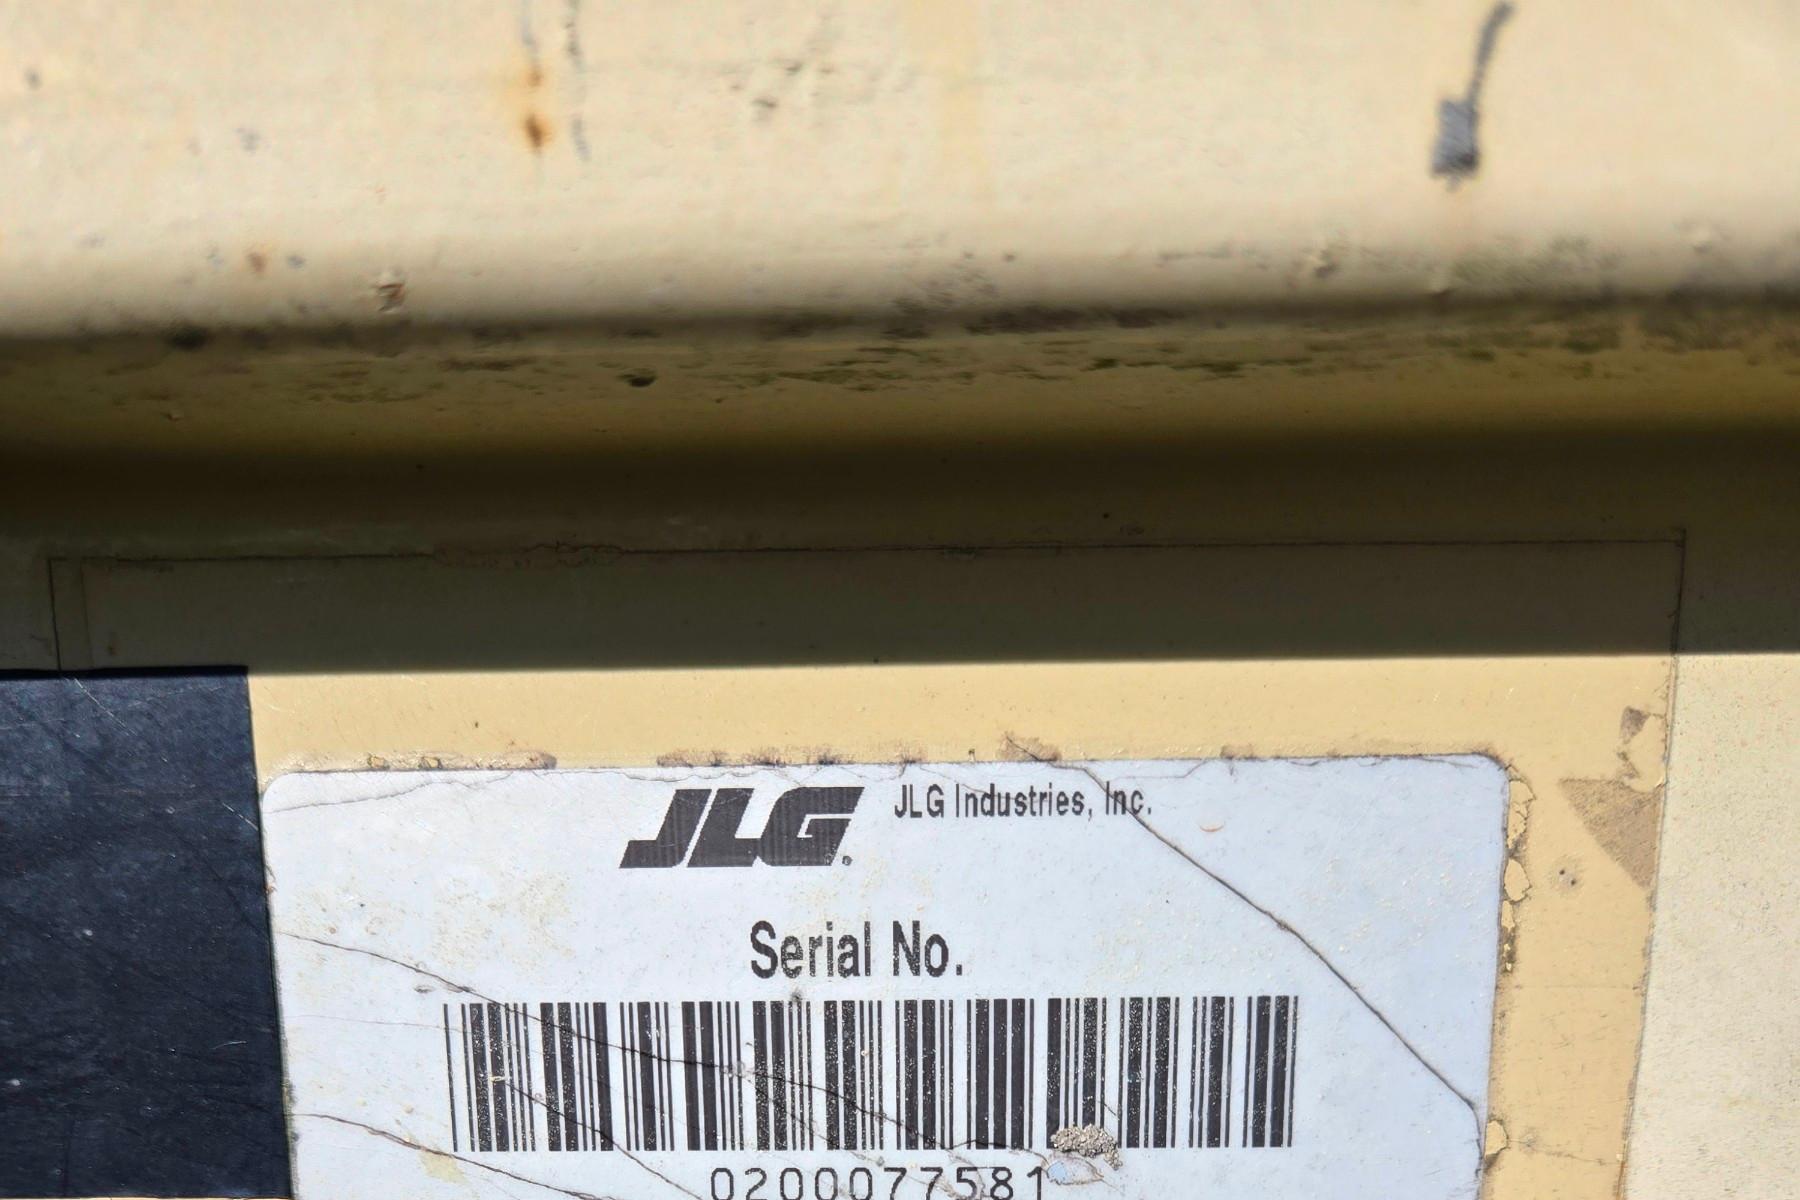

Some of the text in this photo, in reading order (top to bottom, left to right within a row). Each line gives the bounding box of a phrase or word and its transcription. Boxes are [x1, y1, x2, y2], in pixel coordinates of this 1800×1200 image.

[620, 787, 865, 869] JLG
[894, 781, 1152, 822] JLG Industries, Inc.
[750, 920, 964, 979] Serial No.
